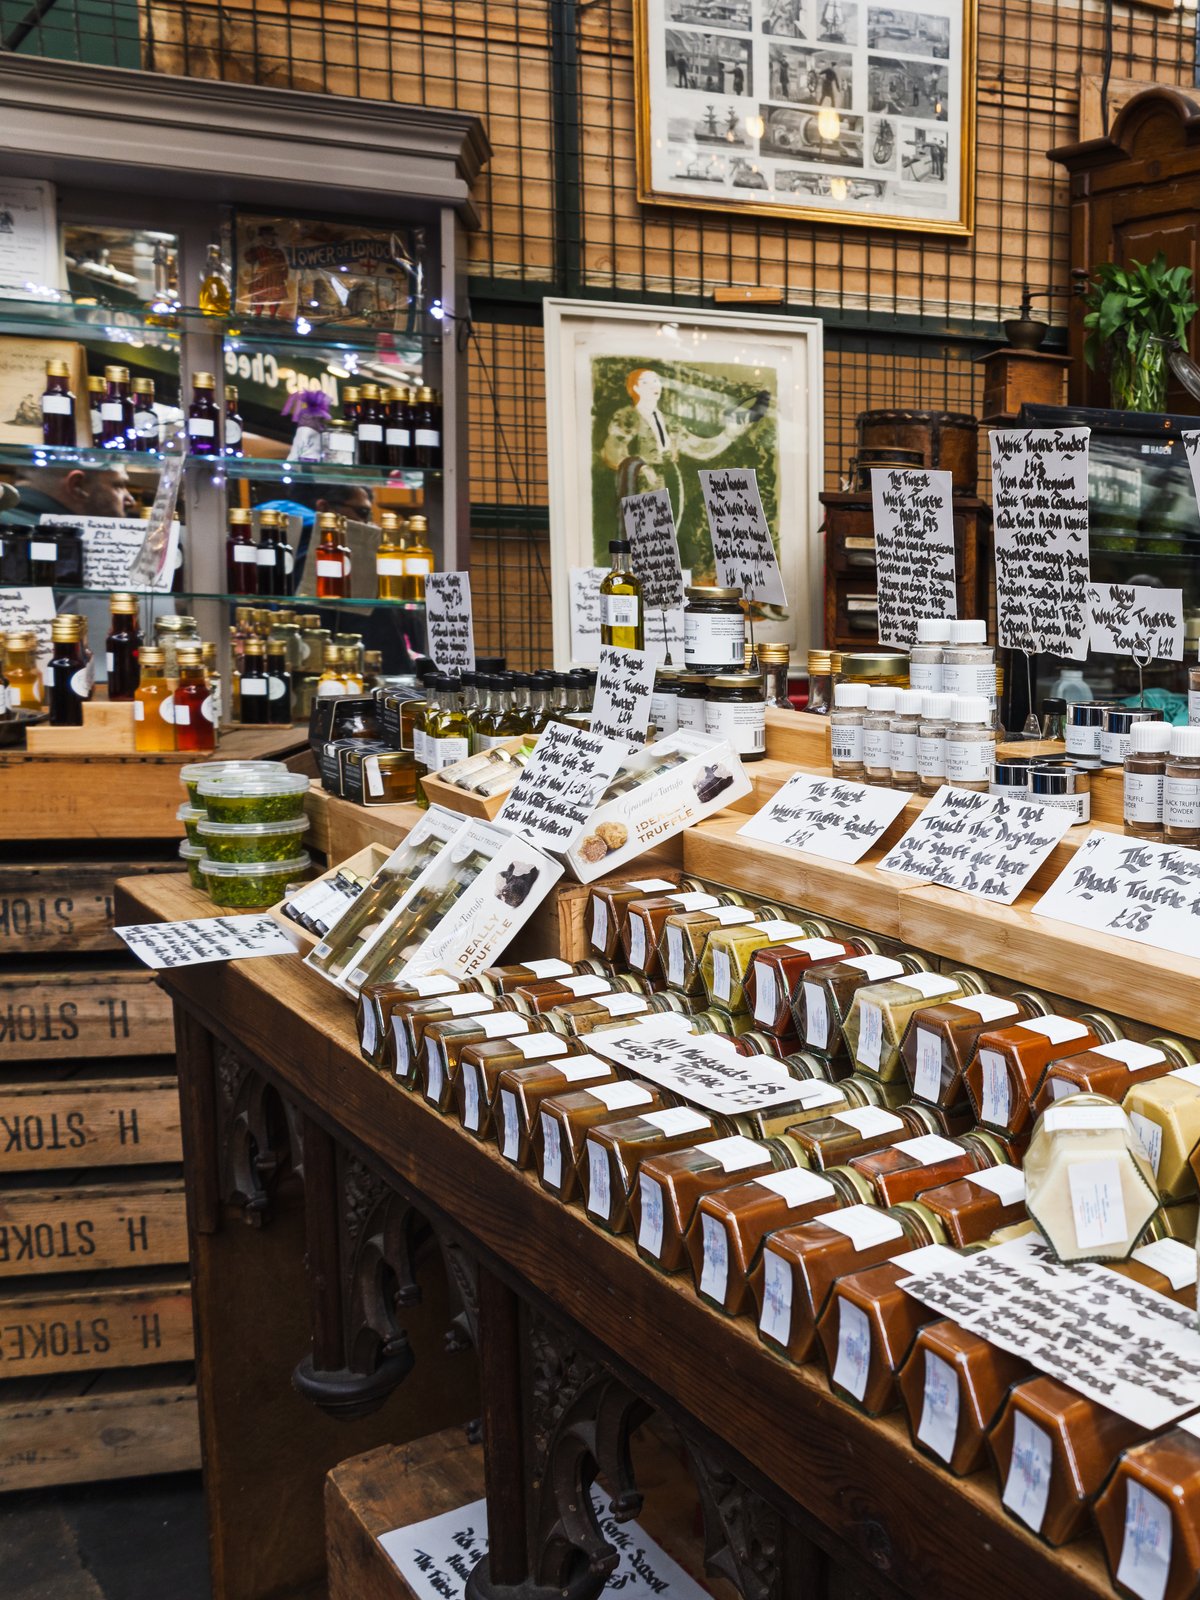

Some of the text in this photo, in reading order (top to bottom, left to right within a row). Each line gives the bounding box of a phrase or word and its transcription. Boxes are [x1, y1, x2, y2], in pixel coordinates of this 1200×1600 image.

[288, 244, 336, 269] TOWER
[1109, 585, 1136, 603] New
[1132, 607, 1177, 628] Truffle
[621, 653, 644, 671] Finest
[623, 679, 649, 696] Truffle
[536, 745, 564, 765] Truffle
[808, 782, 867, 803] The Finest
[942, 791, 989, 819] Kindly
[1127, 795, 1144, 803] TRUFFLE
[805, 810, 845, 826] Truffle
[920, 816, 1057, 854] Touch The Display
[900, 837, 930, 851] Our
[995, 854, 1030, 875] here
[1118, 845, 1154, 866] The
[899, 857, 941, 877] Assist
[980, 877, 1010, 896] Ask
[1066, 865, 1121, 894] Black
[1124, 879, 1187, 909] Truffle
[96, 999, 131, 1039] H.
[3, 1108, 140, 1152] H. STOK
[117, 1216, 149, 1253] H.
[132, 1313, 162, 1350] H.
[627, 1549, 670, 1594] Season
